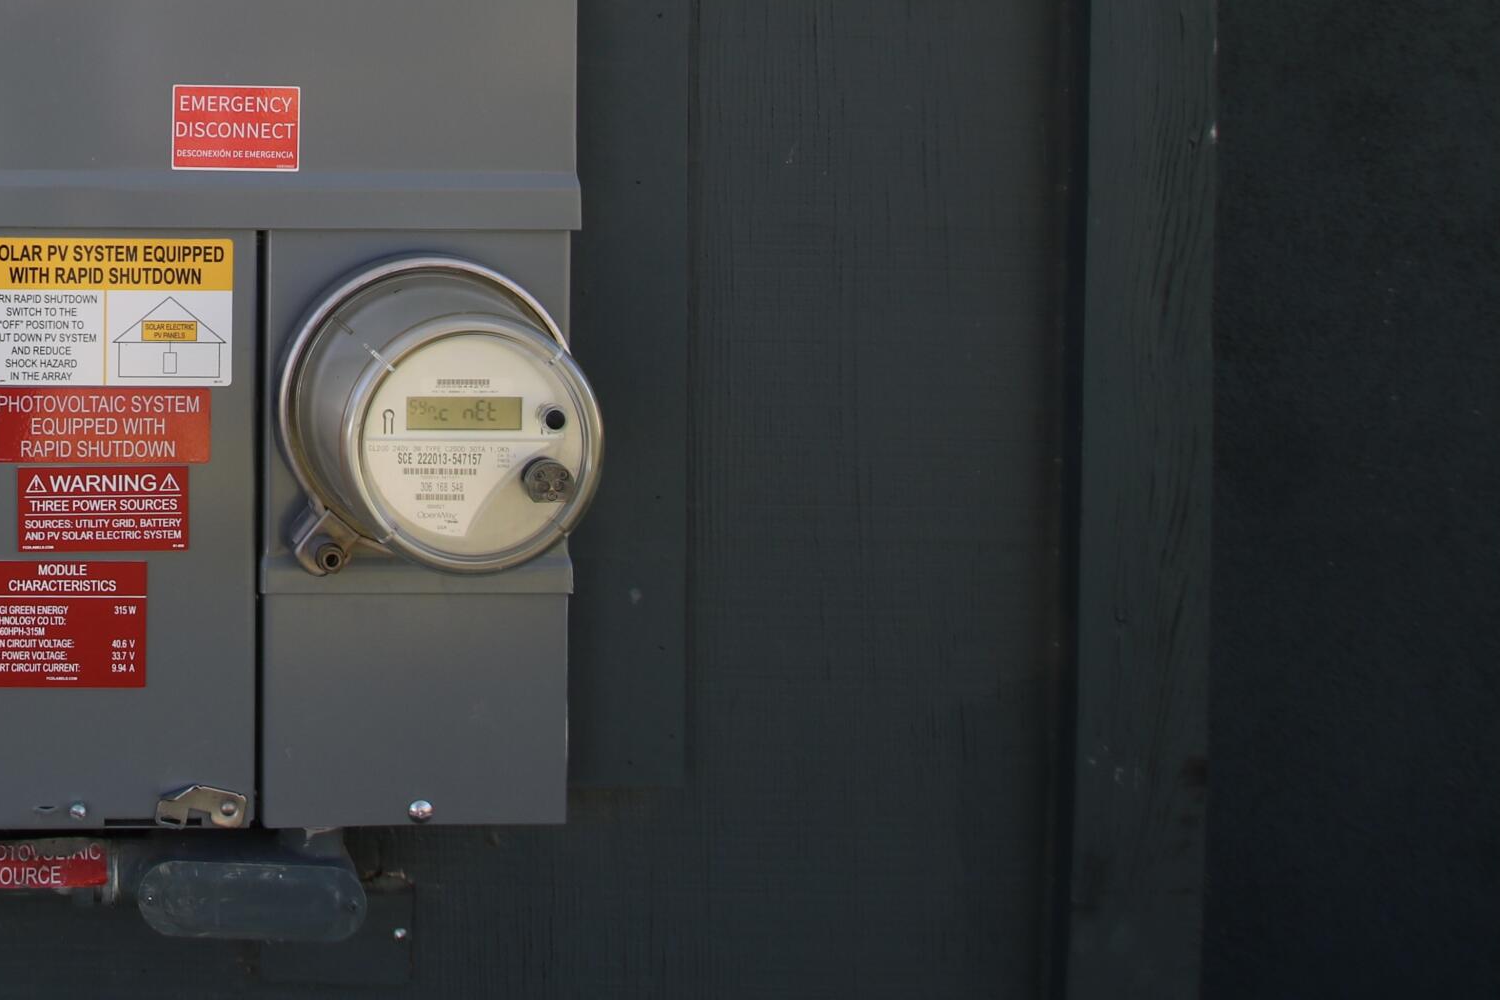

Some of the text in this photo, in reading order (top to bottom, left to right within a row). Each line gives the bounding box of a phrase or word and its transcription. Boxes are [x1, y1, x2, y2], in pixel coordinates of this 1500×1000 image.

[180, 96, 292, 113] EMERGENCY
[176, 122, 295, 139] DISCONNECT
[177, 149, 230, 158] DESCONEXIÓN
[48, 246, 67, 262] PV
[73, 246, 137, 262] SYSTEM
[144, 246, 224, 263] EQUIPPED
[10, 267, 201, 284] WITH RAPID SHUTDOWN
[14, 295, 41, 304] RAPID
[44, 295, 97, 304] SHUTDOWN
[6, 308, 76, 317] SWITCH TO THE
[26, 321, 69, 330] POSITION
[72, 321, 84, 330] TO
[14, 334, 41, 342] DOWN
[45, 334, 57, 342] PV
[60, 334, 96, 342] SYSTEM
[12, 346, 71, 355] AND REDUCE
[5, 359, 77, 368] SHOCK HAZARD
[10, 372, 72, 381] IN THE ARRAY
[131, 396, 199, 413] SYSTEM
[32, 418, 165, 435] EQUIPPED WITH
[21, 441, 175, 458] RAPID SHUTDOWN
[398, 453, 482, 464] SCE 222013-547157
[50, 475, 157, 492] WARNING
[30, 499, 177, 511] THREE POWER SOURCES
[25, 518, 181, 529] SOURCES: UTILITY GRID, BATTERY
[25, 530, 181, 540] AND PV SOLAR ELECTRIC SYSTEM
[38, 565, 87, 575] MODULE
[9, 580, 116, 591] CHARACTERISTICS
[38, 617, 49, 625] CO
[50, 617, 66, 625] LTD:
